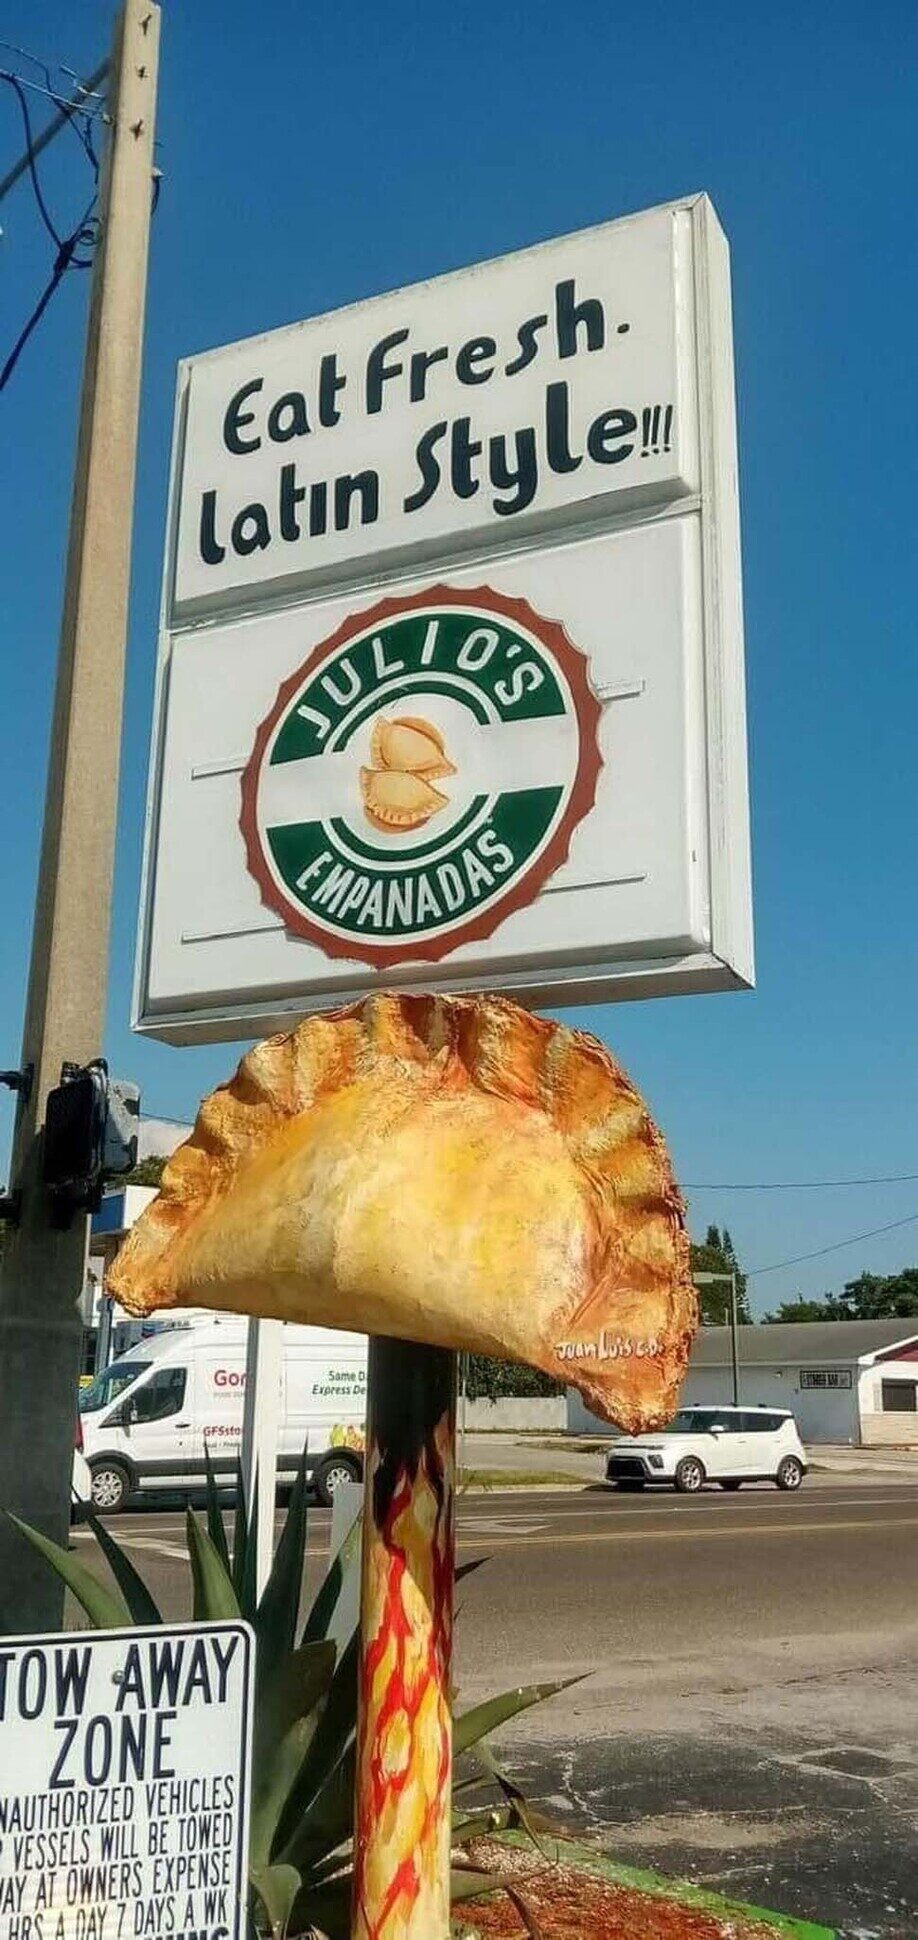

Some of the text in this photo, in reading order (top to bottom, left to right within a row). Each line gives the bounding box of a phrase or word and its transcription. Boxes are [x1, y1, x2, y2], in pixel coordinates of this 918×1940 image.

[223, 353, 346, 455] Eat
[297, 620, 544, 740] JULIO'S
[295, 829, 514, 928] EMPANADAS
[312, 1384, 350, 1396] Express
[115, 1636, 239, 1712] AWAY
[49, 1711, 177, 1789] ZONE
[146, 1775, 234, 1819] VEHICLES
[14, 1829, 90, 1872] VESSELS
[101, 1824, 139, 1862] WILL
[148, 1820, 169, 1856] BE
[178, 1812, 232, 1852] TOWED
[35, 1871, 57, 1910] AT
[66, 1861, 142, 1906] OWNERS
[153, 1849, 231, 1894] EXPENSE
[55, 1911, 65, 1940] A
[76, 1904, 108, 1940] DAY
[117, 1902, 126, 1932] 7
[134, 1895, 175, 1936] DAYS
[183, 1893, 194, 1929] A
[204, 1888, 227, 1925] WK
